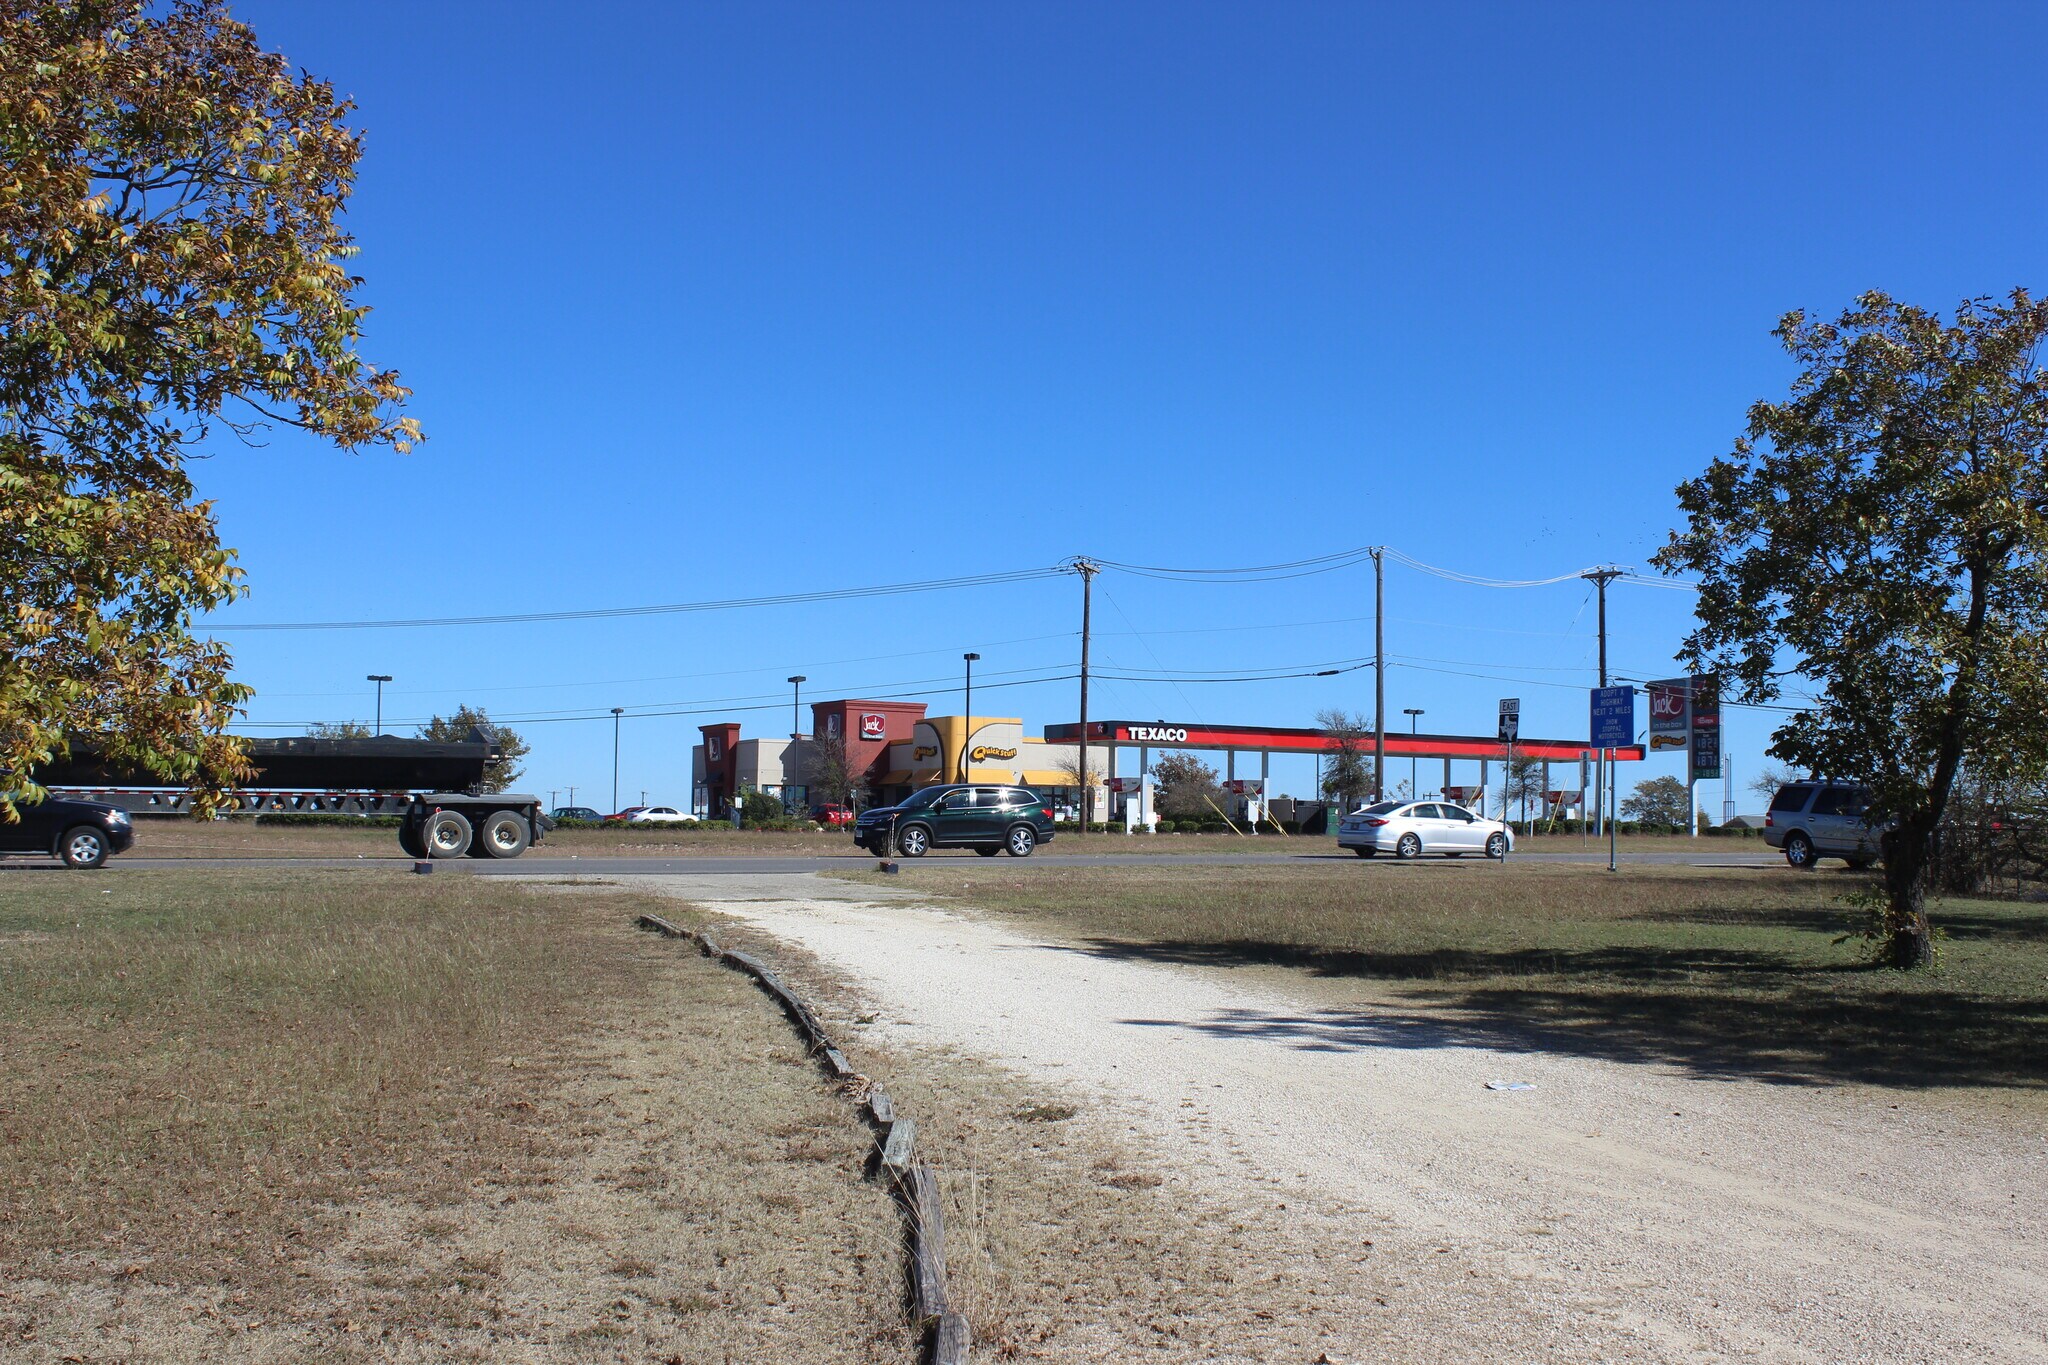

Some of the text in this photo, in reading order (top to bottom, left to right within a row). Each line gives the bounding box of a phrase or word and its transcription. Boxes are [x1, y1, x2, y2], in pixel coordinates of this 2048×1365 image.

[1600, 688, 1624, 697] ADOPT A
[1502, 702, 1516, 711] EAST
[1600, 696, 1623, 706] HIGHWAY
[1652, 688, 1683, 716] Jack
[1593, 706, 1631, 716] NEXT 2 MILES
[863, 716, 884, 731] Jack
[1128, 726, 1187, 742] TEXACO
[973, 746, 1000, 759] Quick
